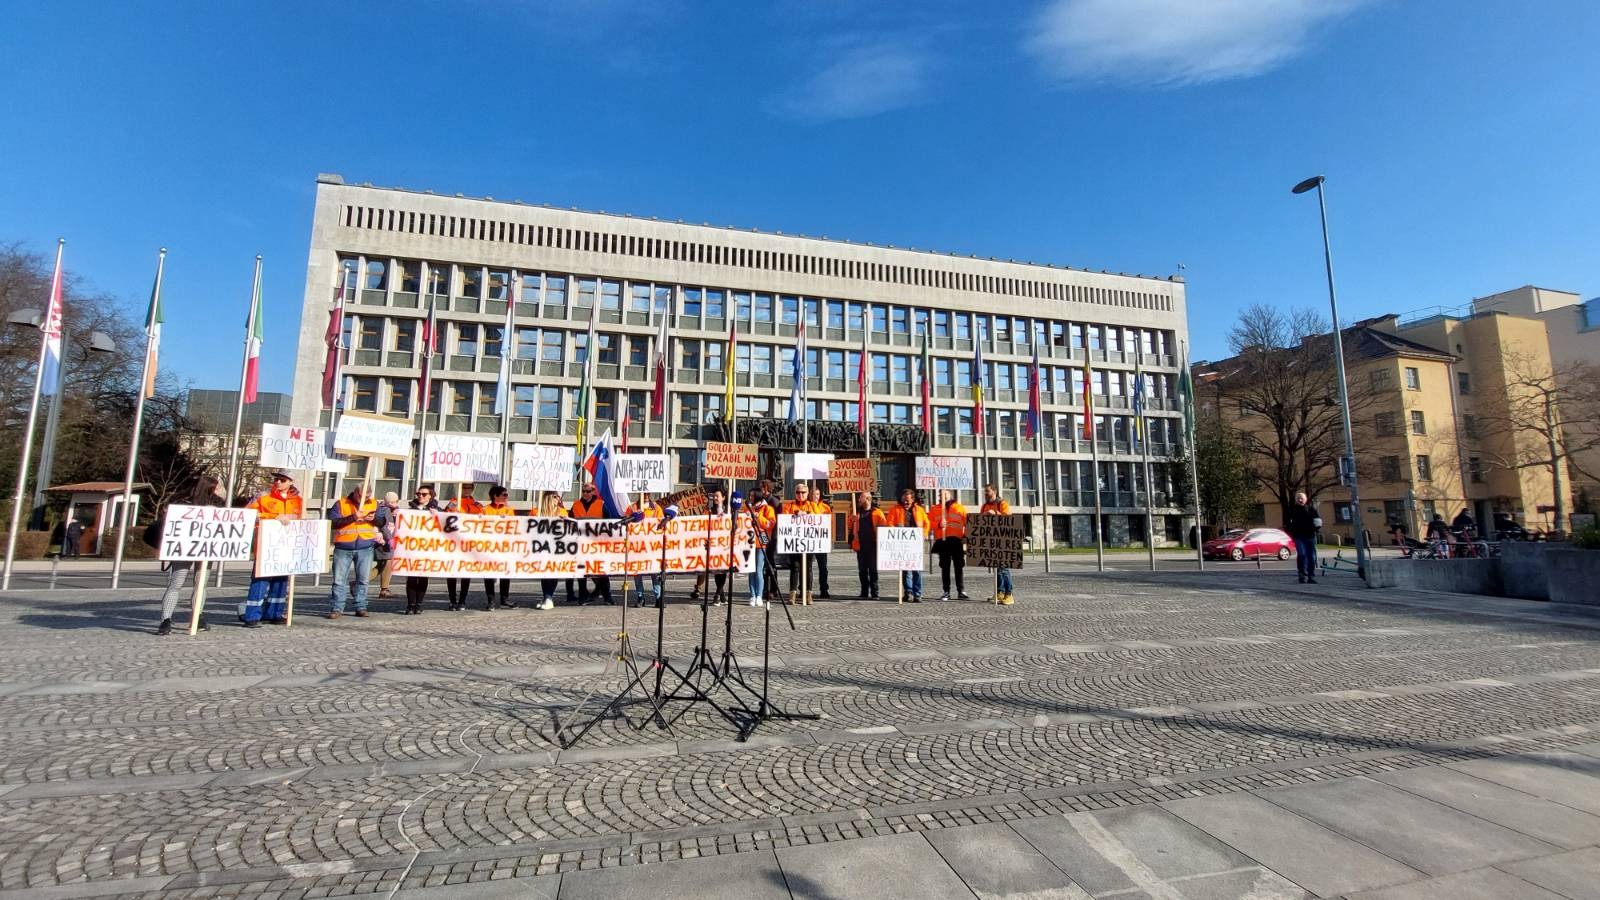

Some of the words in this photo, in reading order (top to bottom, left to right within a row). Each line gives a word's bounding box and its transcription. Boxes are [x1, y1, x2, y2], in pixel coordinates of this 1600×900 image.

[289, 427, 315, 442] NE
[430, 451, 462, 466] 1000
[531, 446, 564, 461] STOP
[707, 453, 742, 464] POZABIL
[745, 455, 757, 463] NA
[705, 464, 733, 478] SVOJO
[631, 479, 650, 492] EUR
[830, 480, 842, 491] VAS
[181, 507, 205, 520] ZA
[212, 509, 246, 523] KOGA
[165, 520, 181, 537] JE
[189, 521, 246, 539] PISAN
[398, 514, 442, 533] NIKA
[443, 515, 460, 533] &
[460, 519, 521, 535] STEGEL
[778, 527, 793, 536] NAM
[794, 526, 801, 537] JE
[887, 529, 917, 541] NIKA
[166, 541, 183, 557] TA
[186, 541, 251, 559] ZAKON?
[392, 536, 457, 553] MORAMO
[531, 540, 551, 554] DA
[554, 541, 579, 556] BO
[263, 548, 280, 562] JE
[979, 549, 1023, 561] PRISOTEN
